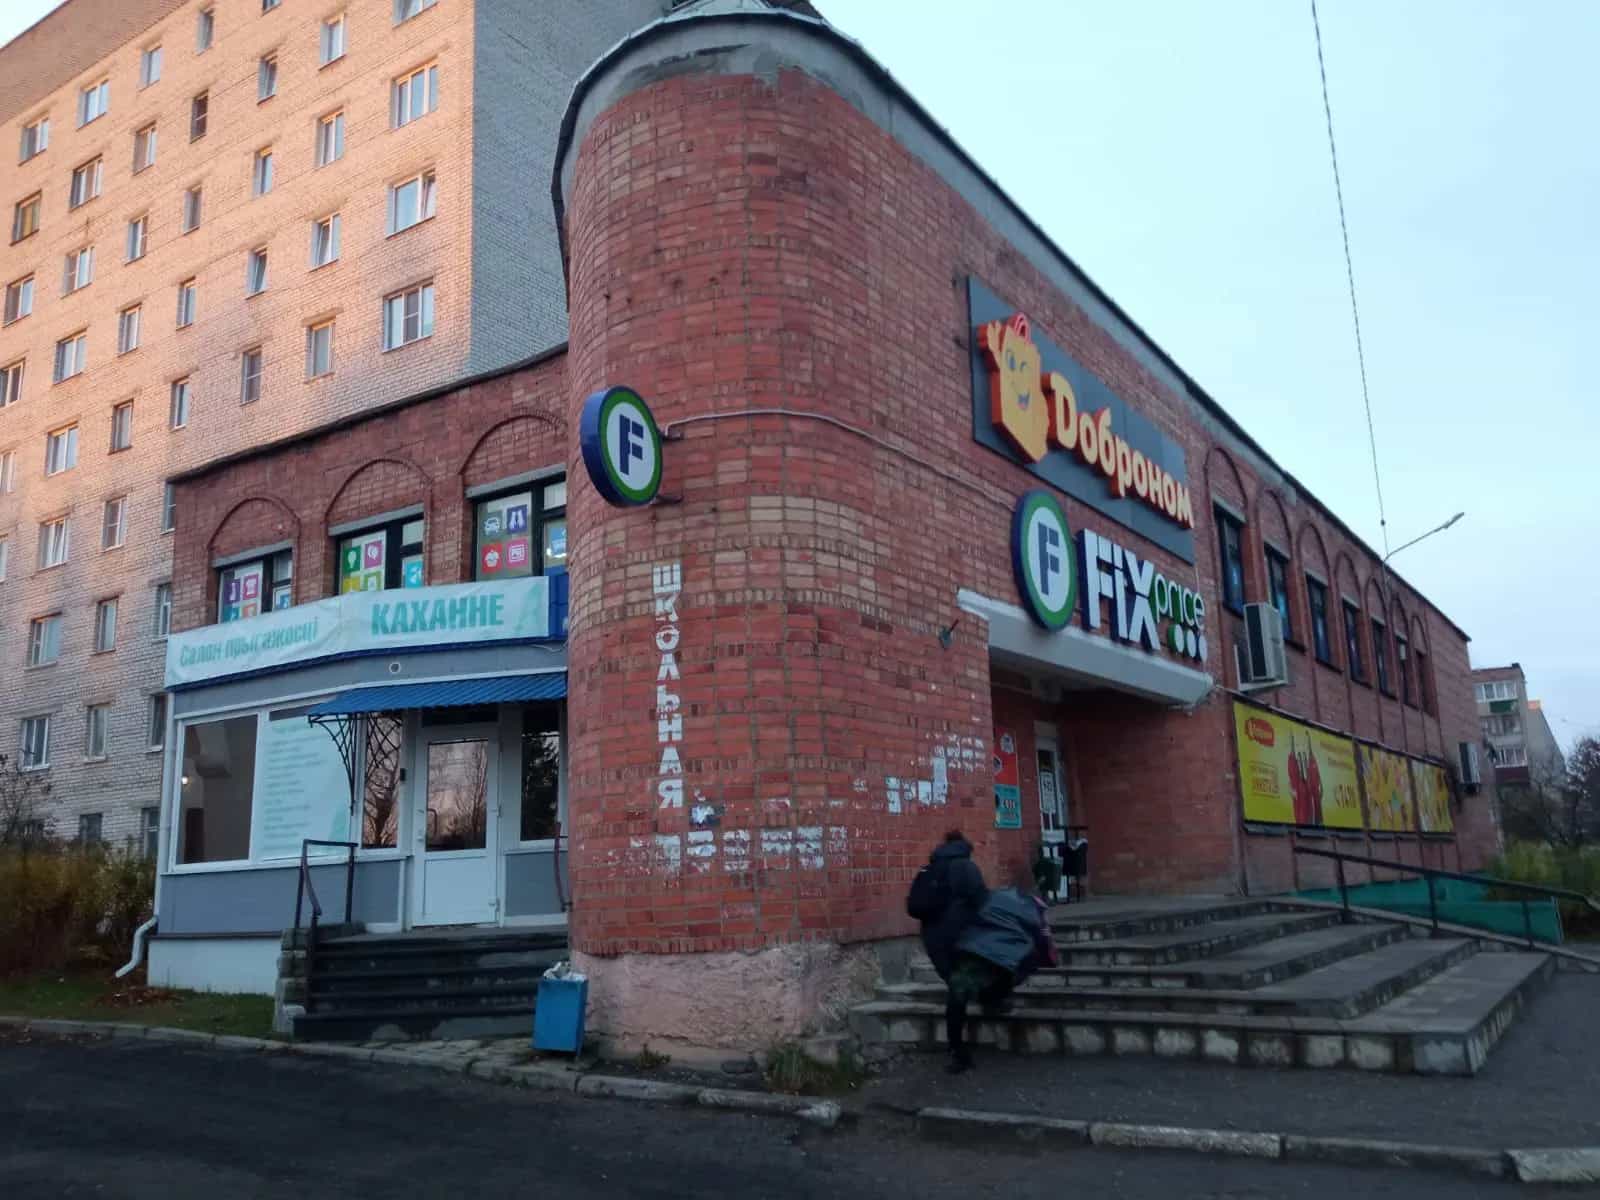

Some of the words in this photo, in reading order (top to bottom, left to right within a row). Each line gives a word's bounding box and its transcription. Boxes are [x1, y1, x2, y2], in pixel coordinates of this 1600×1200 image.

[619, 413, 644, 475] F
[1038, 521, 1060, 596] F
[371, 594, 505, 636] КАХАННЕ
[1155, 573, 1206, 630] price
[180, 641, 222, 667] Салон
[653, 563, 684, 809] ШКОЛЬНАЯ
